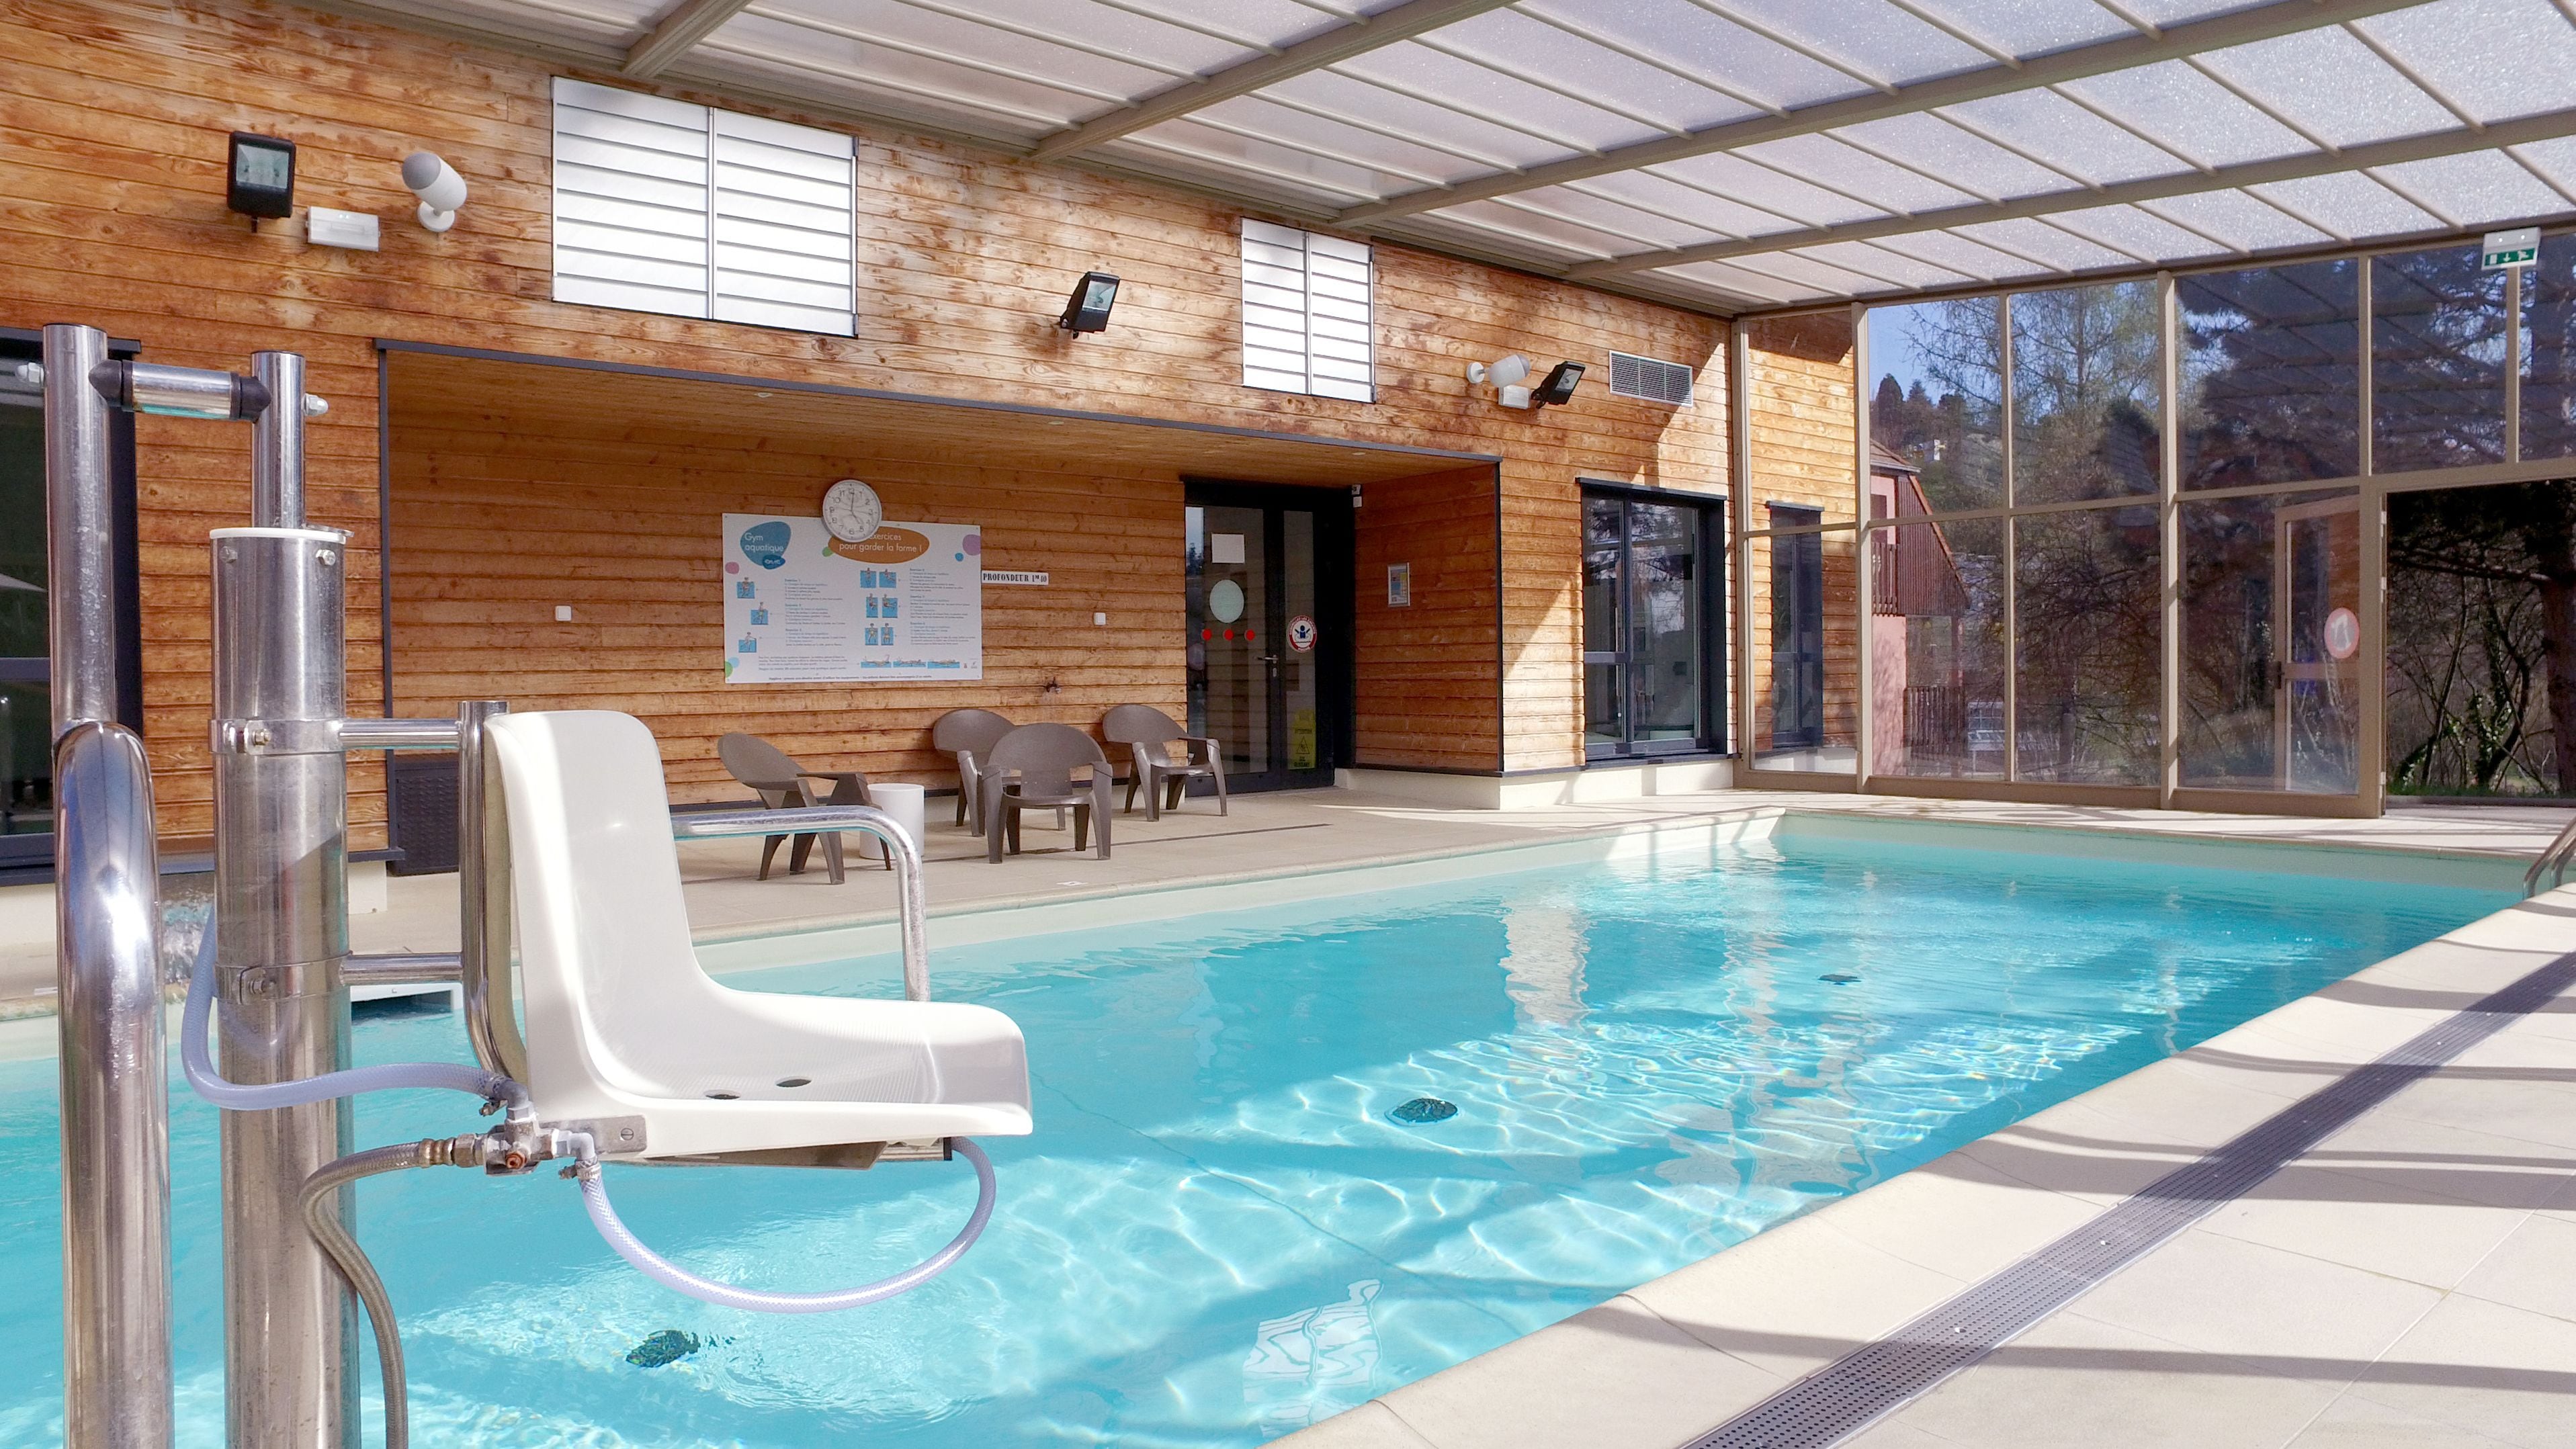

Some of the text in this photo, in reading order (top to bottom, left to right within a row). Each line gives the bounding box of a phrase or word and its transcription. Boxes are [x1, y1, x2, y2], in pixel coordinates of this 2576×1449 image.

[744, 532, 763, 543] Gym
[871, 532, 902, 541] xercices
[745, 544, 784, 554] aquatique
[839, 543, 857, 552] pour
[859, 542, 884, 552] garder
[887, 542, 894, 551] la
[896, 543, 916, 552] forme
[983, 573, 1029, 582] PROFONDEUR
